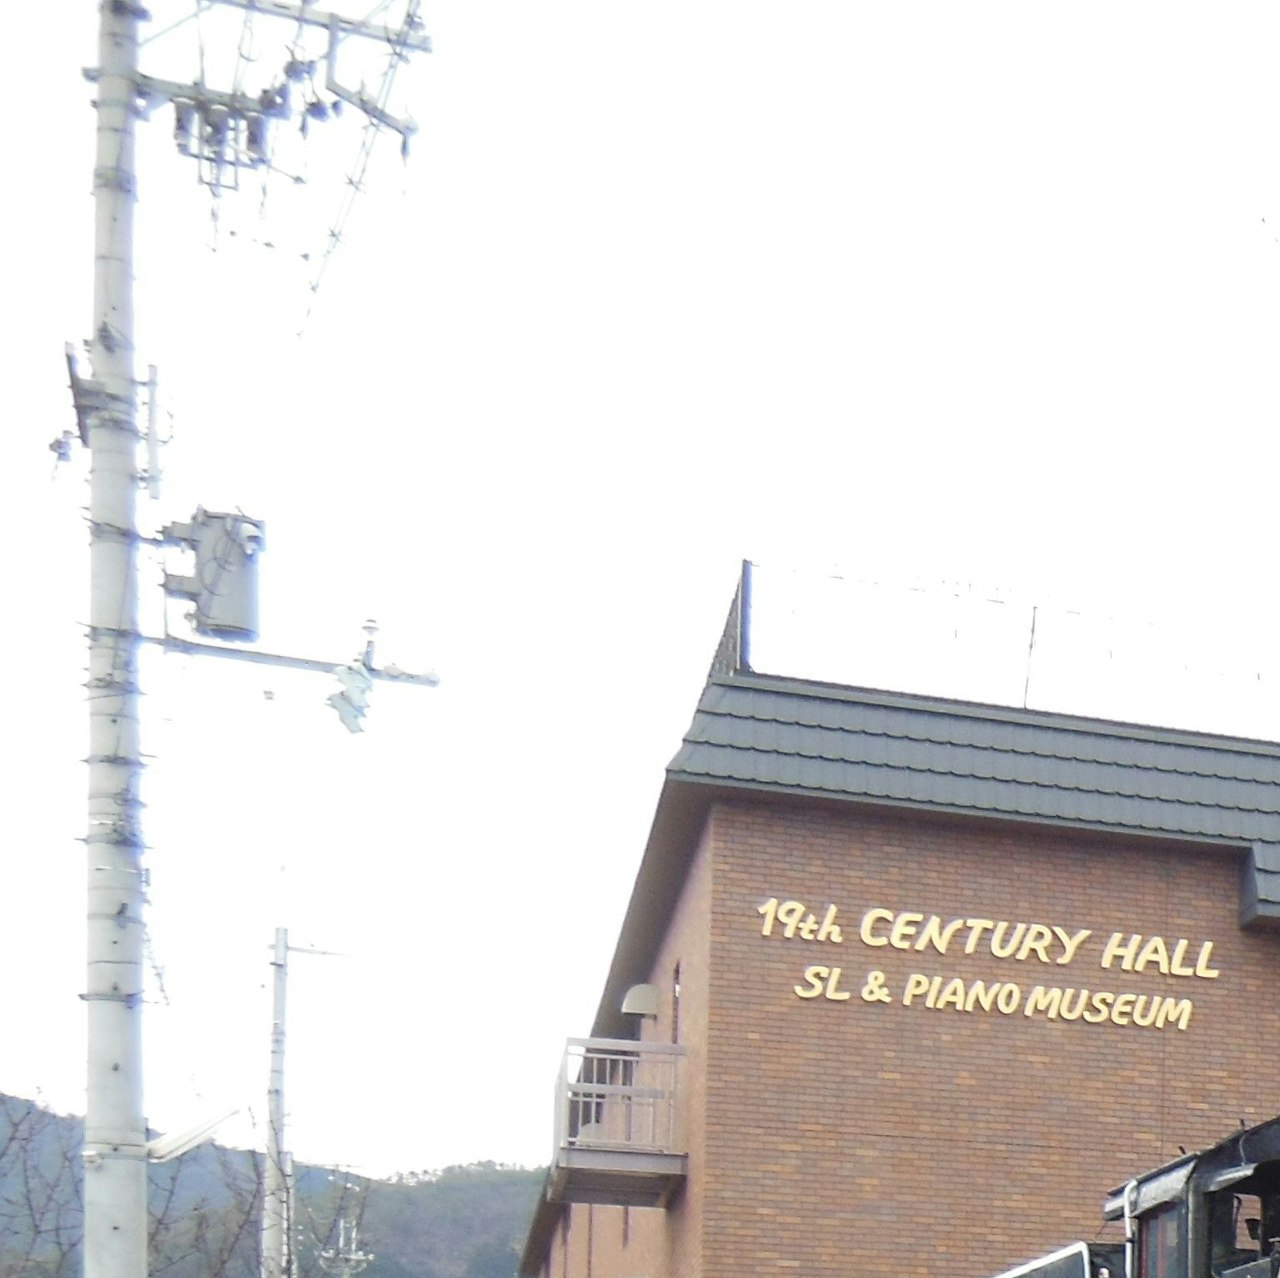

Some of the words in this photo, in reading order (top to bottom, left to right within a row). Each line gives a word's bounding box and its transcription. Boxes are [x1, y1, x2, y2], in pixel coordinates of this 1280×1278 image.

[758, 898, 844, 942] 19th
[859, 908, 1092, 964] CENTURY
[1101, 932, 1220, 978] HALL
[793, 966, 850, 1000] SL
[860, 970, 892, 1003] &
[903, 973, 1018, 1014] PIANO
[1024, 986, 1193, 1030] MUSEUM
